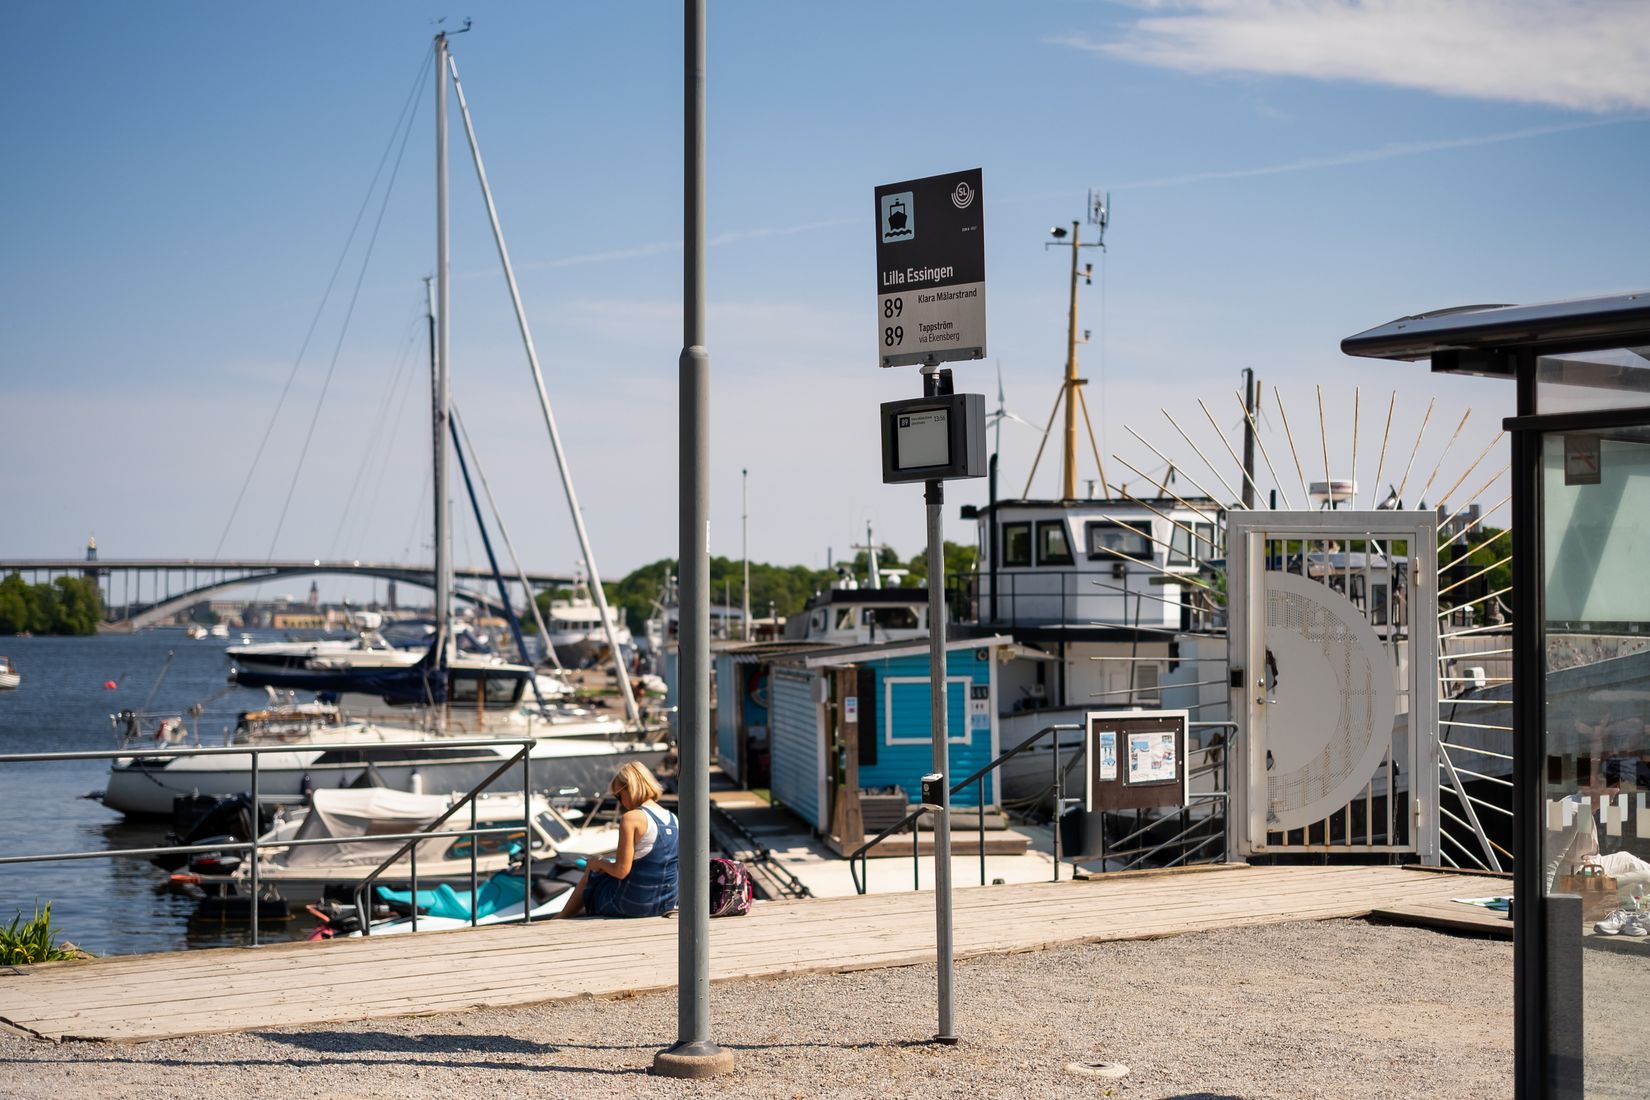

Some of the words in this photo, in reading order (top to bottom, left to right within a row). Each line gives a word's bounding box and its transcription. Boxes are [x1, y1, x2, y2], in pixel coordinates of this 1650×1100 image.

[958, 187, 967, 197] SL
[883, 270, 905, 286] Lilla
[907, 266, 954, 283] Essingen
[918, 294, 935, 304] Klara
[936, 288, 977, 301] Mälarstrand
[884, 297, 903, 318] 89
[885, 326, 904, 346] 89
[919, 321, 953, 335] Tappström
[919, 335, 928, 343] via
[928, 332, 960, 343] Ekensberg
